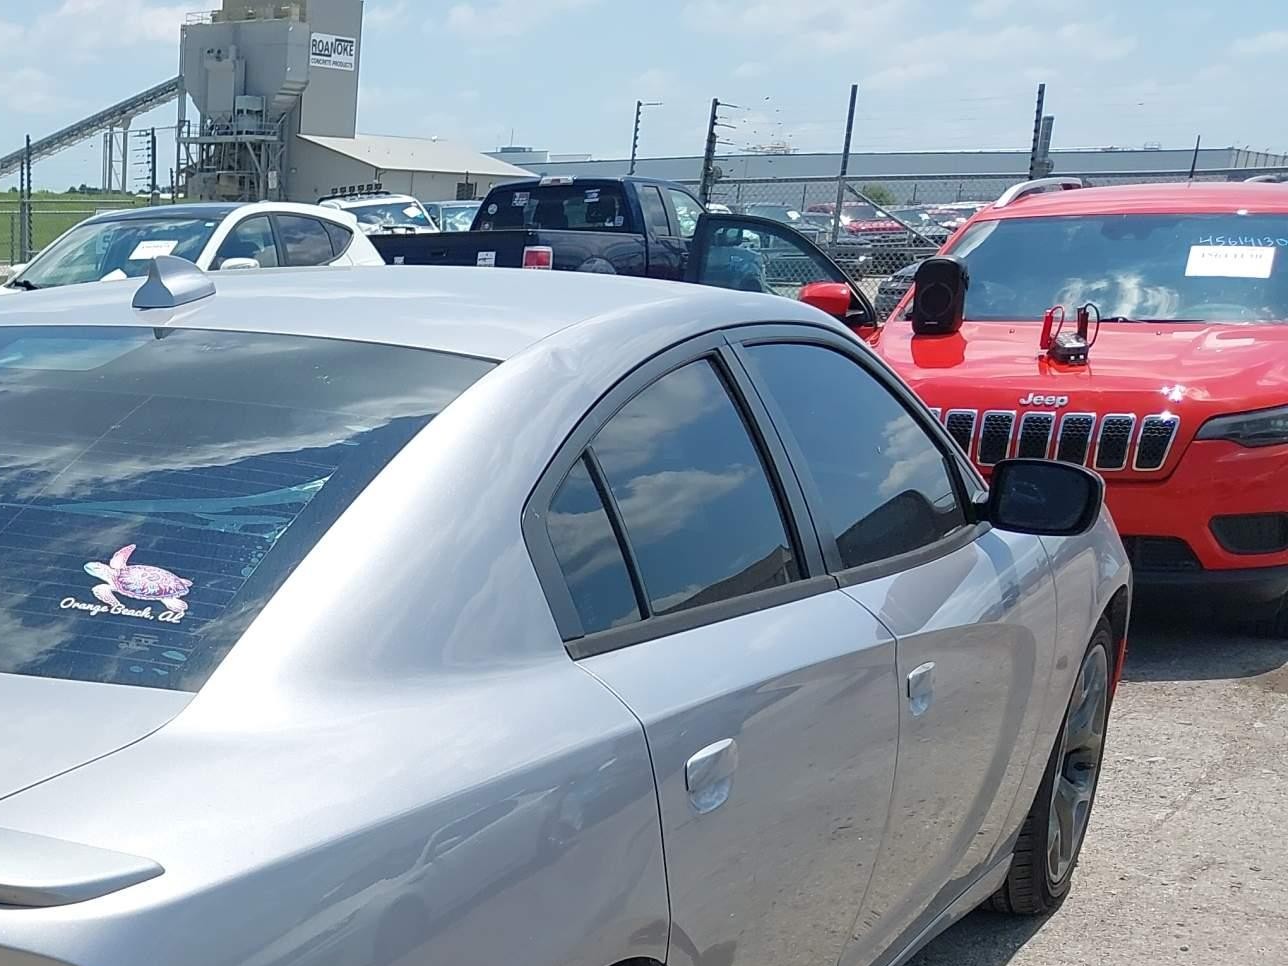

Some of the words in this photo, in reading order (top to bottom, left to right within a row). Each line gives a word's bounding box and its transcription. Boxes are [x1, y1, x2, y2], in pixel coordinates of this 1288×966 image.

[312, 38, 354, 57] ROANOKE
[1019, 393, 1069, 408] Jeep
[60, 597, 109, 616] Orange
[111, 604, 154, 620] Beach,
